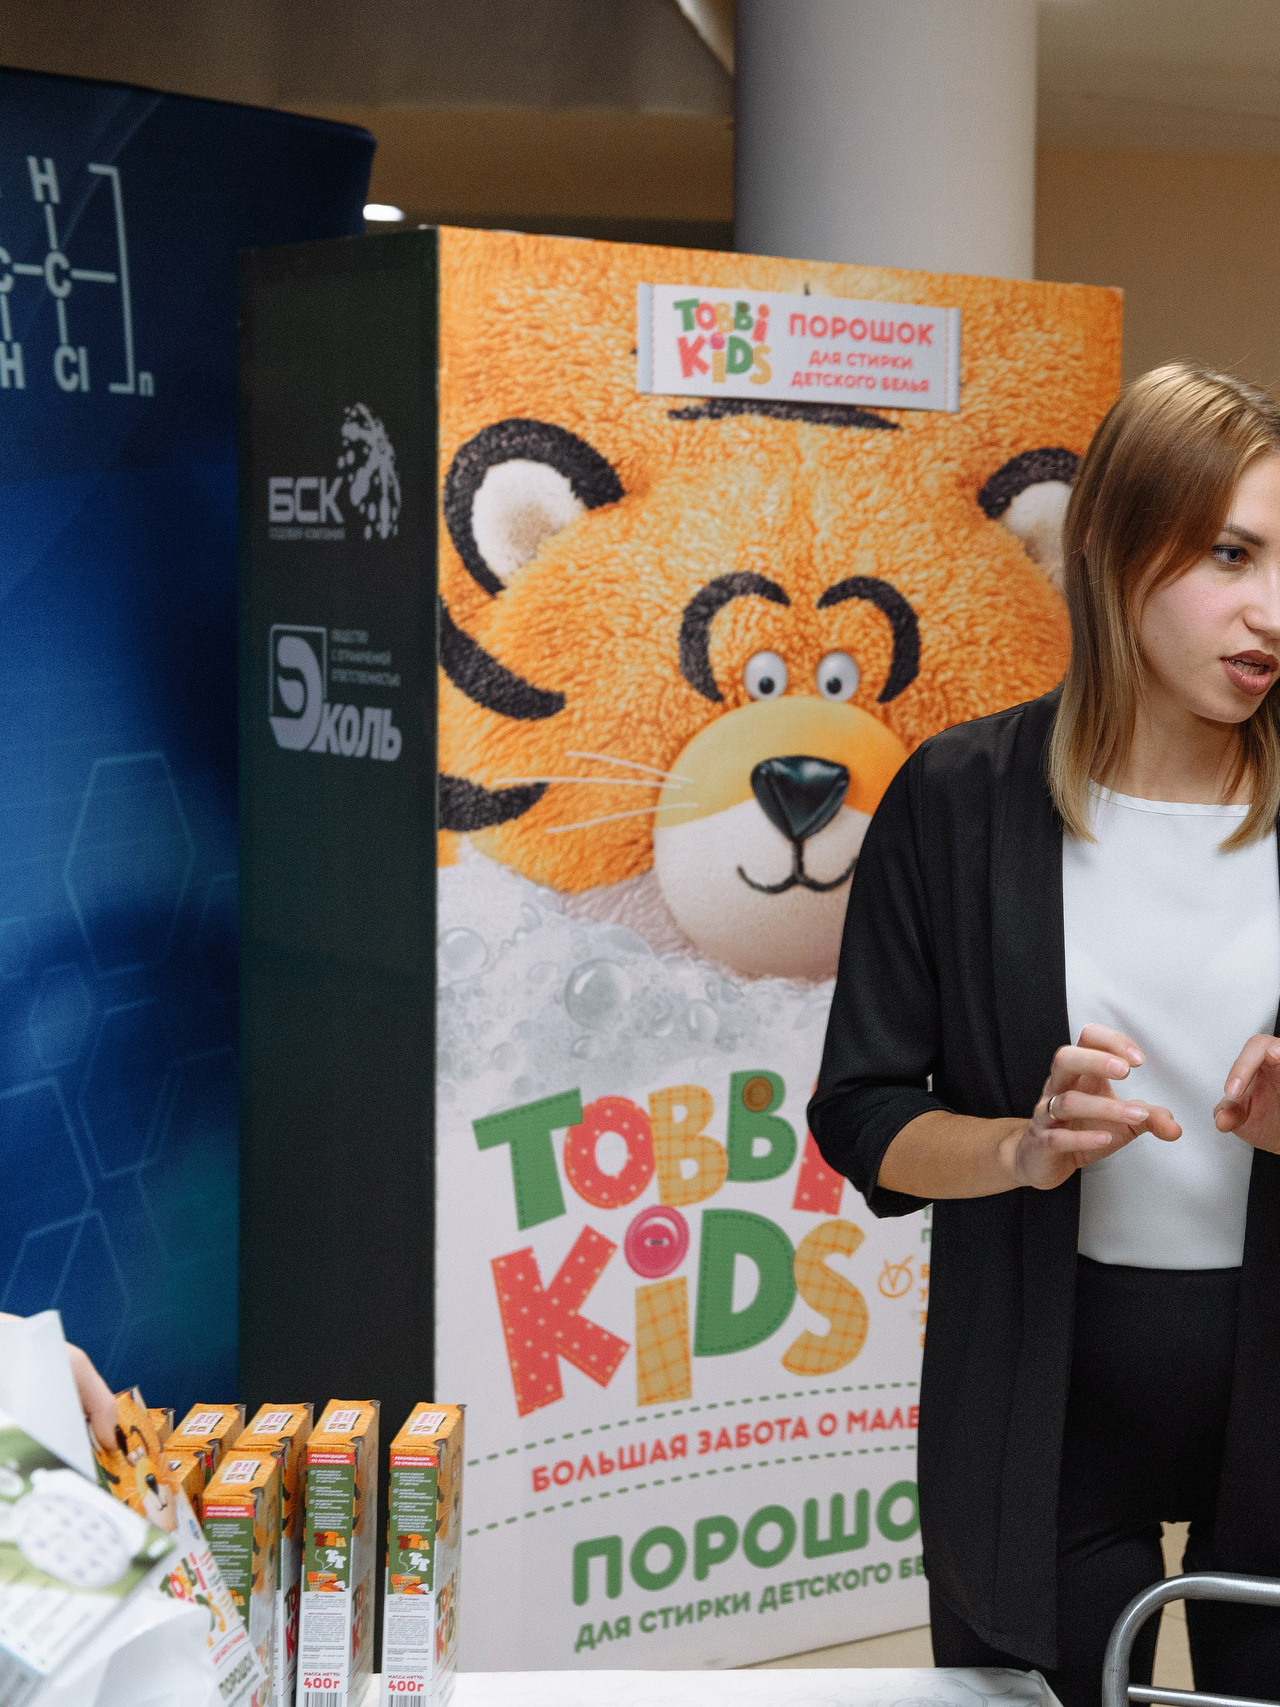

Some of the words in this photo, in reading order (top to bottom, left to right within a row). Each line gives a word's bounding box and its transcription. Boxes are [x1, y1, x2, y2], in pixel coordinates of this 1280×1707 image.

[27, 155, 61, 204] H
[789, 312, 934, 347] ПОРОШОК
[790, 370, 877, 391] ДЕТСКОГО
[881, 375, 930, 393] БЕЛЬЯ
[808, 349, 842, 367] ДЛЯ
[845, 351, 913, 370] СТИРКИ
[269, 476, 344, 524] БСК
[531, 1434, 688, 1493] БОЛЬШАЯ
[697, 1412, 809, 1456] ЗАБОТА
[817, 1412, 838, 1438] О
[573, 1616, 632, 1654] ДЛЯ
[639, 1590, 751, 1635] СТИРКИ
[758, 1561, 892, 1614] ДЕТСКОГО
